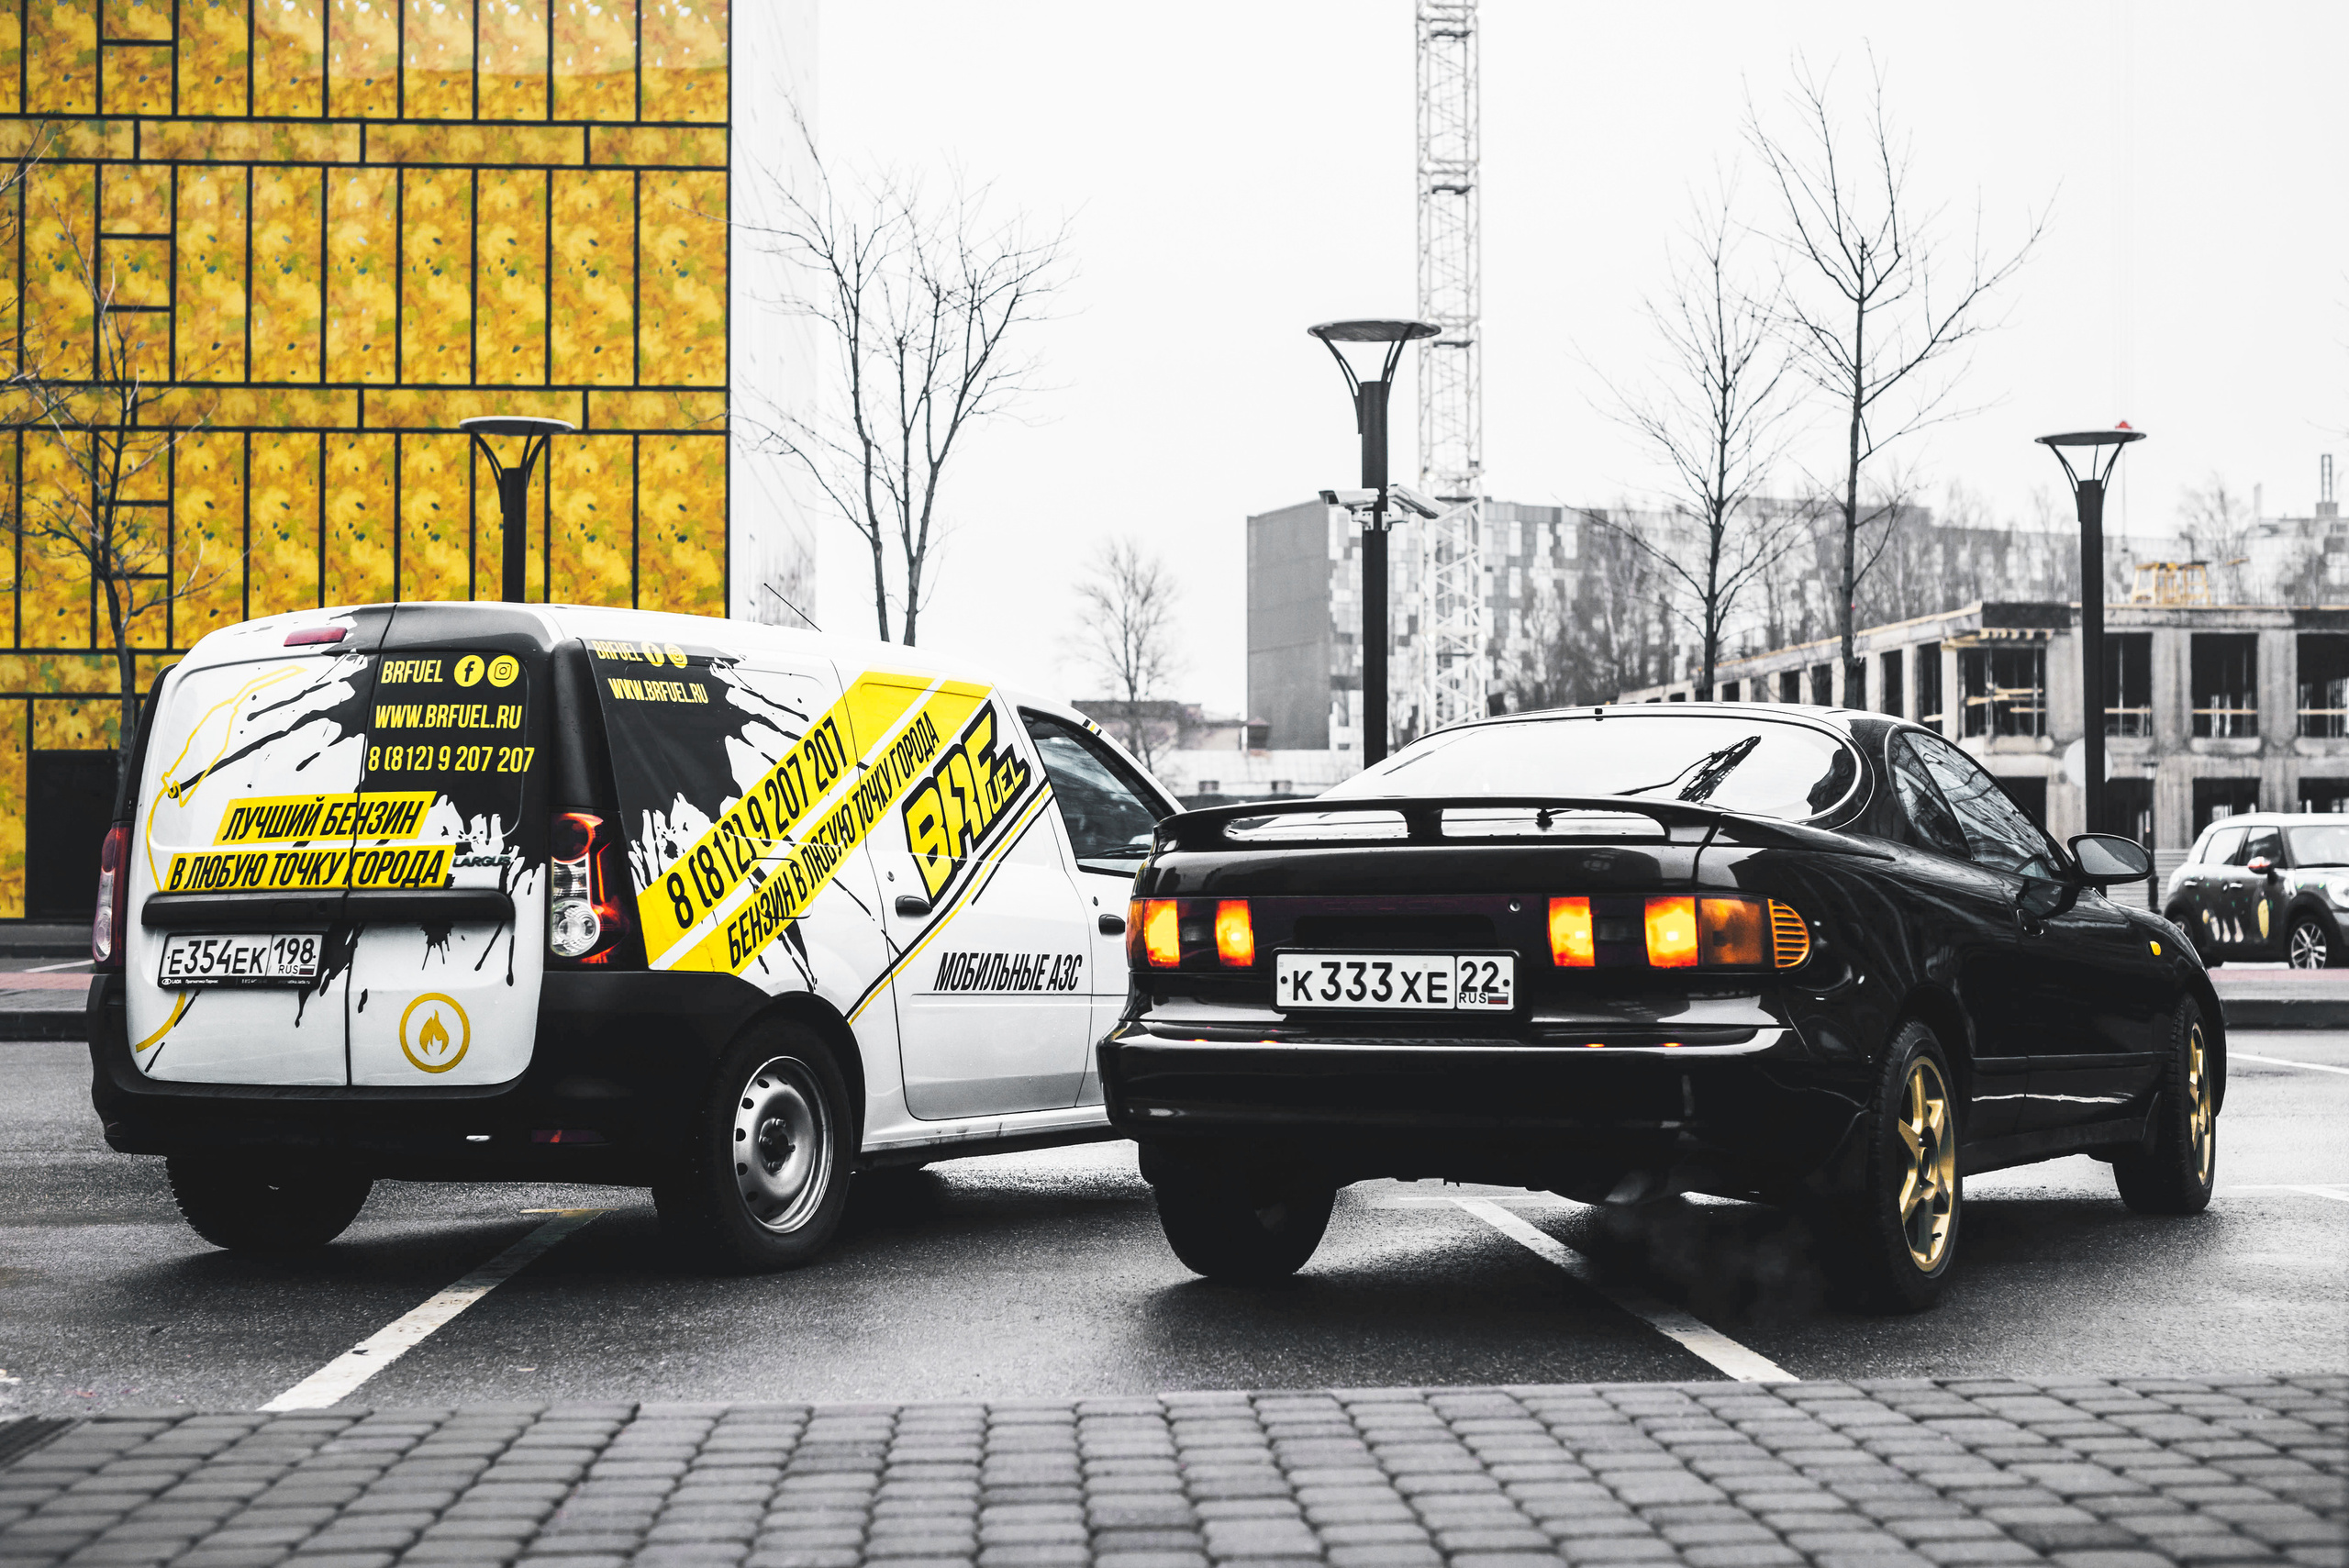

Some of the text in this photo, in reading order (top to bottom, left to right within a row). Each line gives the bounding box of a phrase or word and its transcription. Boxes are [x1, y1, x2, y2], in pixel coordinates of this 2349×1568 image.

[590, 640, 644, 662] BRFUEL
[380, 660, 443, 684] BRFUEL
[607, 678, 709, 704] WWW.BRFUEL.RU
[374, 705, 522, 729] WWW.BRFUEL.RU
[368, 745, 535, 773] 8 (812) 9 207 207
[222, 797, 425, 840] ЛУЧШИЙ БЕНЗИН
[666, 716, 848, 929] 8 (812) 9 207 207
[727, 710, 941, 969] БЕНЗИН В ЛЮБУЮ ТОЧКУ ГОРОДА
[169, 850, 447, 890] В ЛЮБУЮ ТОЧКУ ГОРОДА
[452, 856, 512, 868] LARGUS
[274, 938, 315, 965] 198
[278, 964, 298, 974] RUS
[933, 952, 1083, 992] МОБИЛЬНЫЕ АЗС
[1460, 961, 1499, 994] 22
[1458, 992, 1487, 1005] RUS
